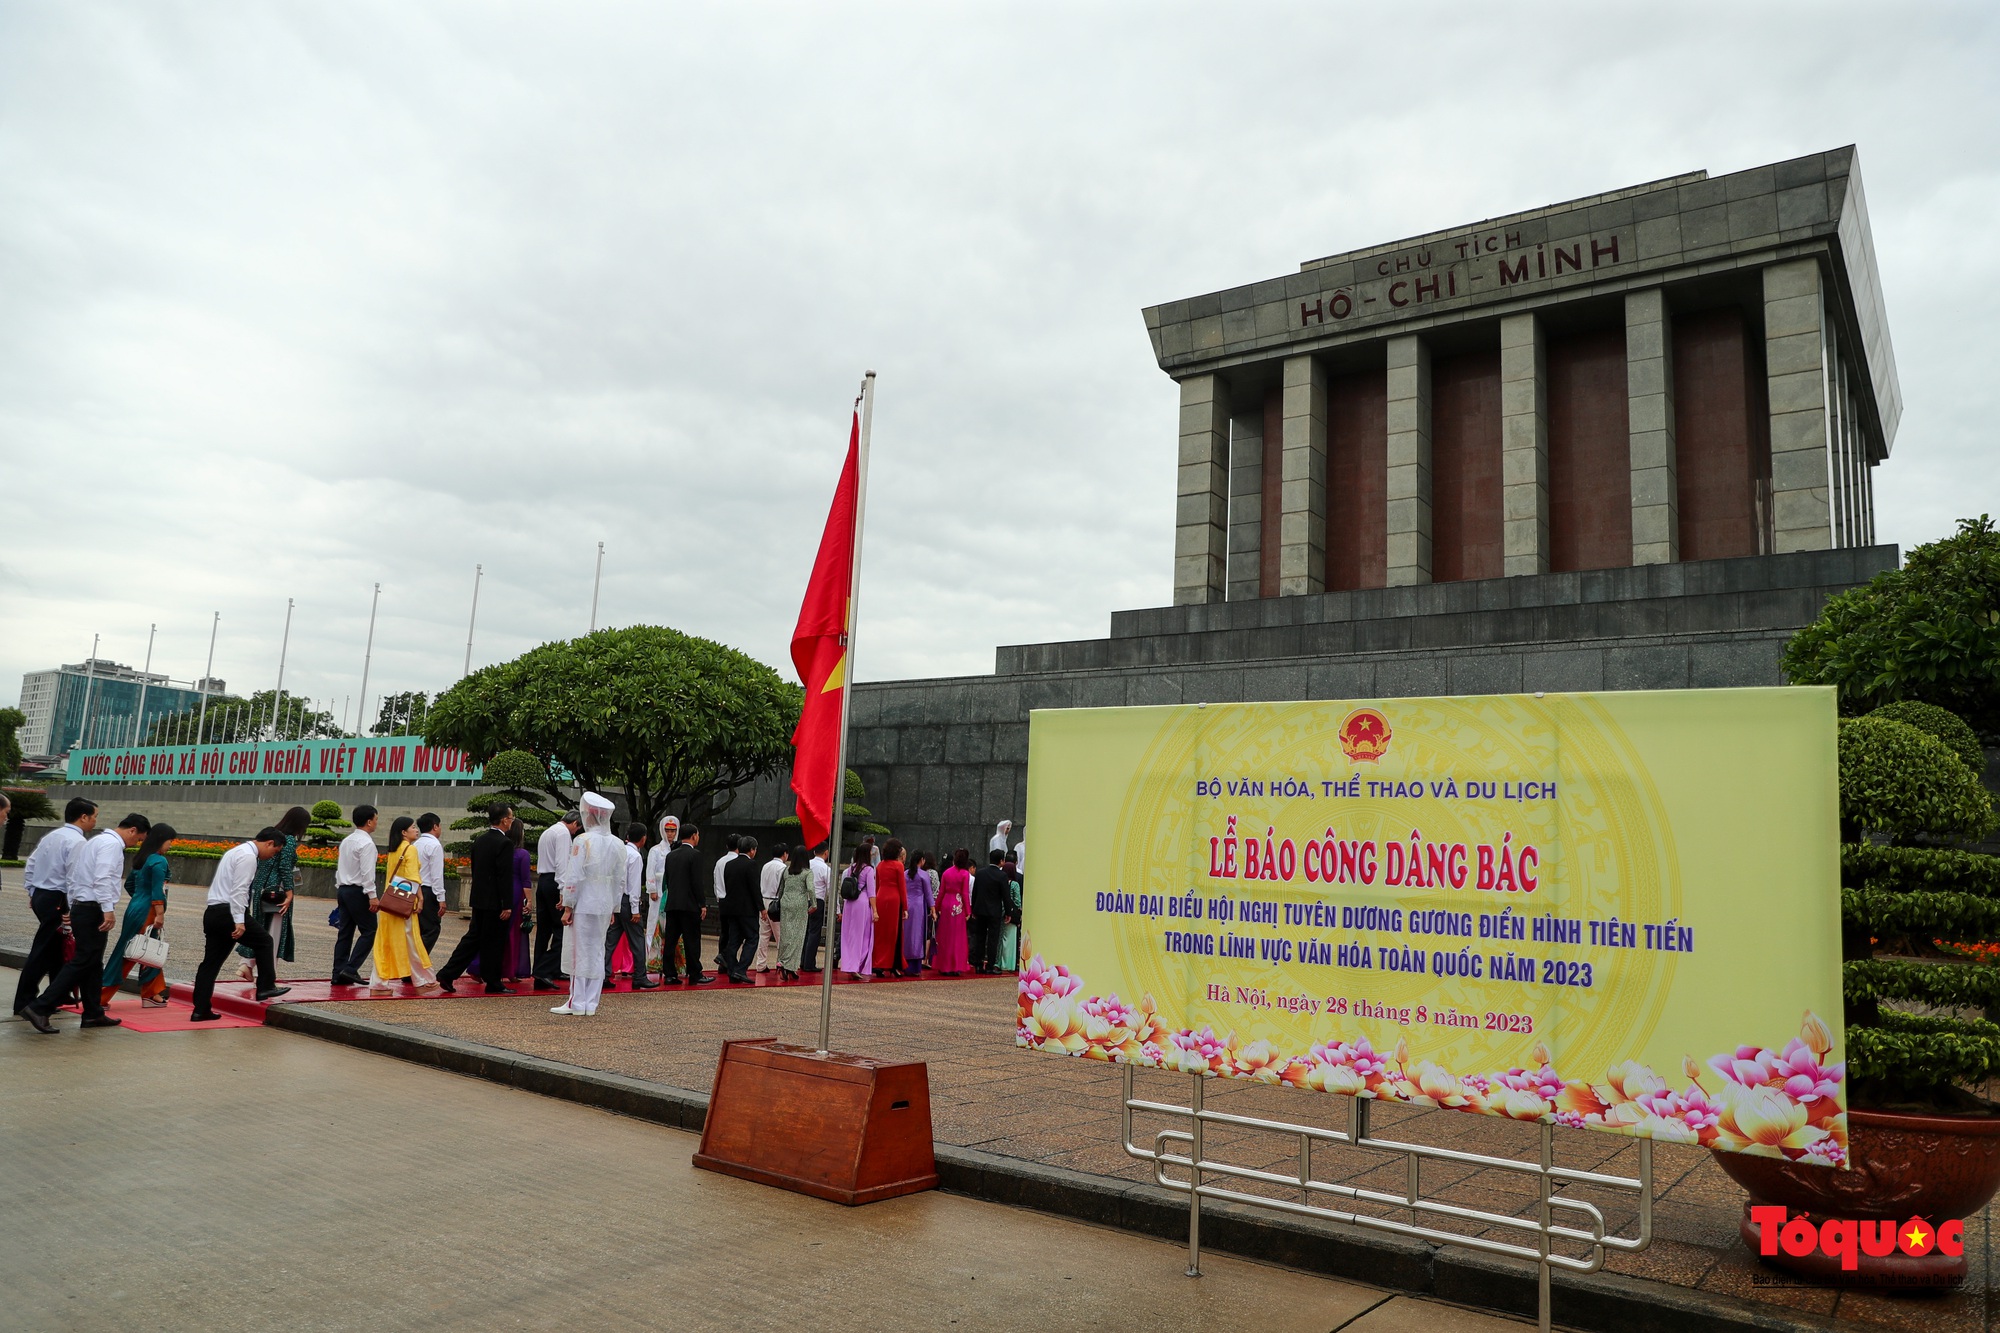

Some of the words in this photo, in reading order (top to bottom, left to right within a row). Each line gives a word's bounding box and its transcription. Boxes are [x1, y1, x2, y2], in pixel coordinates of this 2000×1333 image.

[81, 751, 111, 776] NƯỚC
[114, 751, 146, 780] CỘNG
[149, 749, 174, 775] HÒA
[178, 748, 196, 775] XÃ
[200, 747, 225, 778] HỘI
[229, 744, 258, 774] CHỦ
[263, 744, 311, 774] NGHĨA
[320, 743, 357, 778] VIỆT
[362, 746, 406, 773] NAM
[1196, 777, 1222, 799] BỘ
[1227, 777, 1264, 797] VĂN
[1270, 777, 1315, 800] HÓA,
[1321, 773, 1361, 798] THỂ
[1367, 781, 1424, 798] THAO
[1431, 778, 1459, 799] VÀ
[1466, 781, 1496, 799] DU
[1503, 782, 1556, 803] LỊCH
[1208, 815, 1239, 880] LỄ
[1243, 826, 1297, 882] BÁO
[1304, 826, 1378, 886] CÔNG
[1385, 829, 1468, 889] DÂNG
[1475, 832, 1539, 893] BÁC
[1096, 889, 1135, 914] ĐOÀN
[1139, 894, 1163, 920] ĐẠI
[1169, 889, 1202, 919] BIỂU
[1208, 895, 1234, 925] HỘI
[1239, 900, 1279, 929] NGHỊ
[1284, 901, 1336, 929] TUYÊN
[1342, 904, 1402, 932] DƯƠNG
[1408, 909, 1472, 937] GƯƠNG
[1479, 906, 1525, 941] ĐIỂN
[1532, 912, 1582, 945] HÌNH
[1589, 917, 1636, 948] TIÊN
[1643, 917, 1694, 953] TIẾN
[1164, 931, 1214, 956] TRONG
[1219, 932, 1255, 960] LĨNH
[1260, 937, 1292, 966] VỰC
[1298, 938, 1331, 966] VĂN
[1337, 941, 1373, 969] HÓA
[1378, 943, 1426, 973] TOÀN
[1432, 945, 1483, 979] QUỐC
[1489, 951, 1536, 983] NĂM
[1542, 959, 1594, 988] 2023
[1206, 983, 1231, 1005] Hà
[1235, 986, 1271, 1009] Nội,
[1277, 994, 1321, 1016] ngày
[1325, 995, 1349, 1016] 28
[1353, 999, 1411, 1025] tháng
[1416, 1005, 1428, 1024] 8
[1434, 1008, 1480, 1029] năm
[1484, 1011, 1534, 1034] 2023
